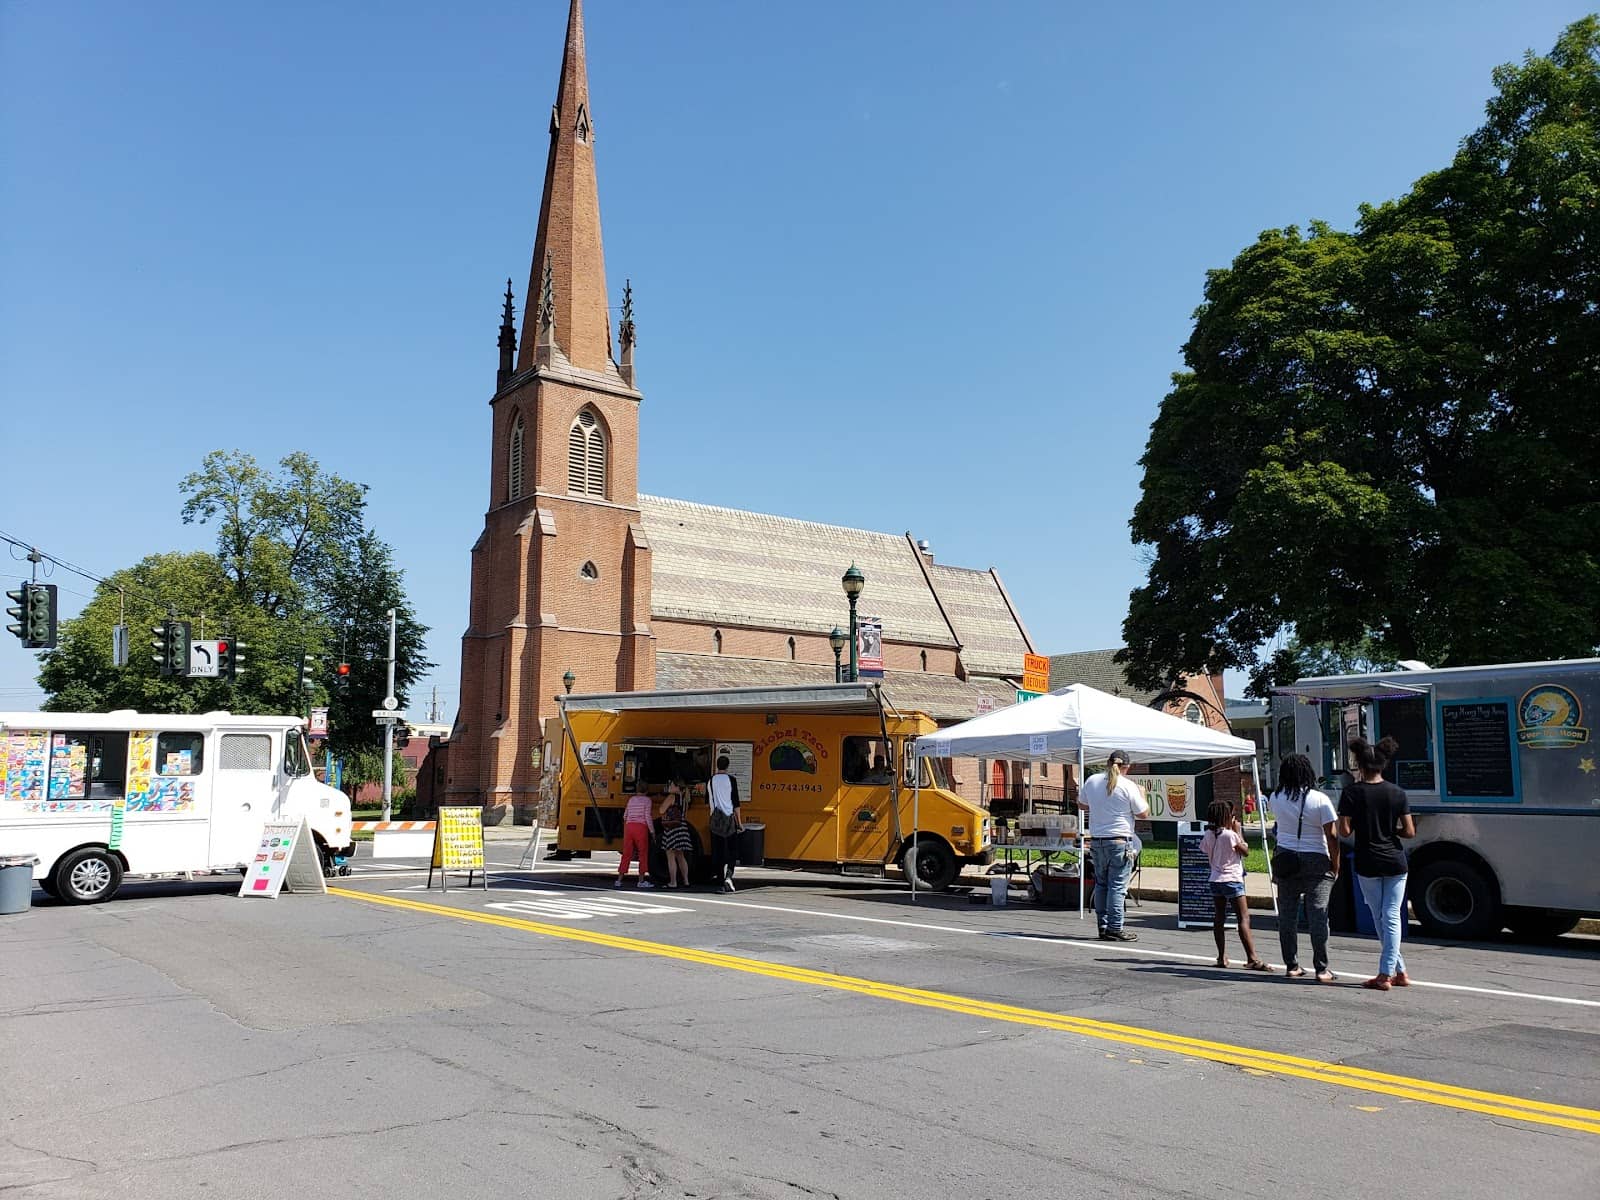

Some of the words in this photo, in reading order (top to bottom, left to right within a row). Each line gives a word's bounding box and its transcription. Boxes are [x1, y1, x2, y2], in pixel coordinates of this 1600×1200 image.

[1026, 657, 1047, 672] TRUCK
[754, 728, 798, 756] Global
[801, 729, 828, 759] Taco
